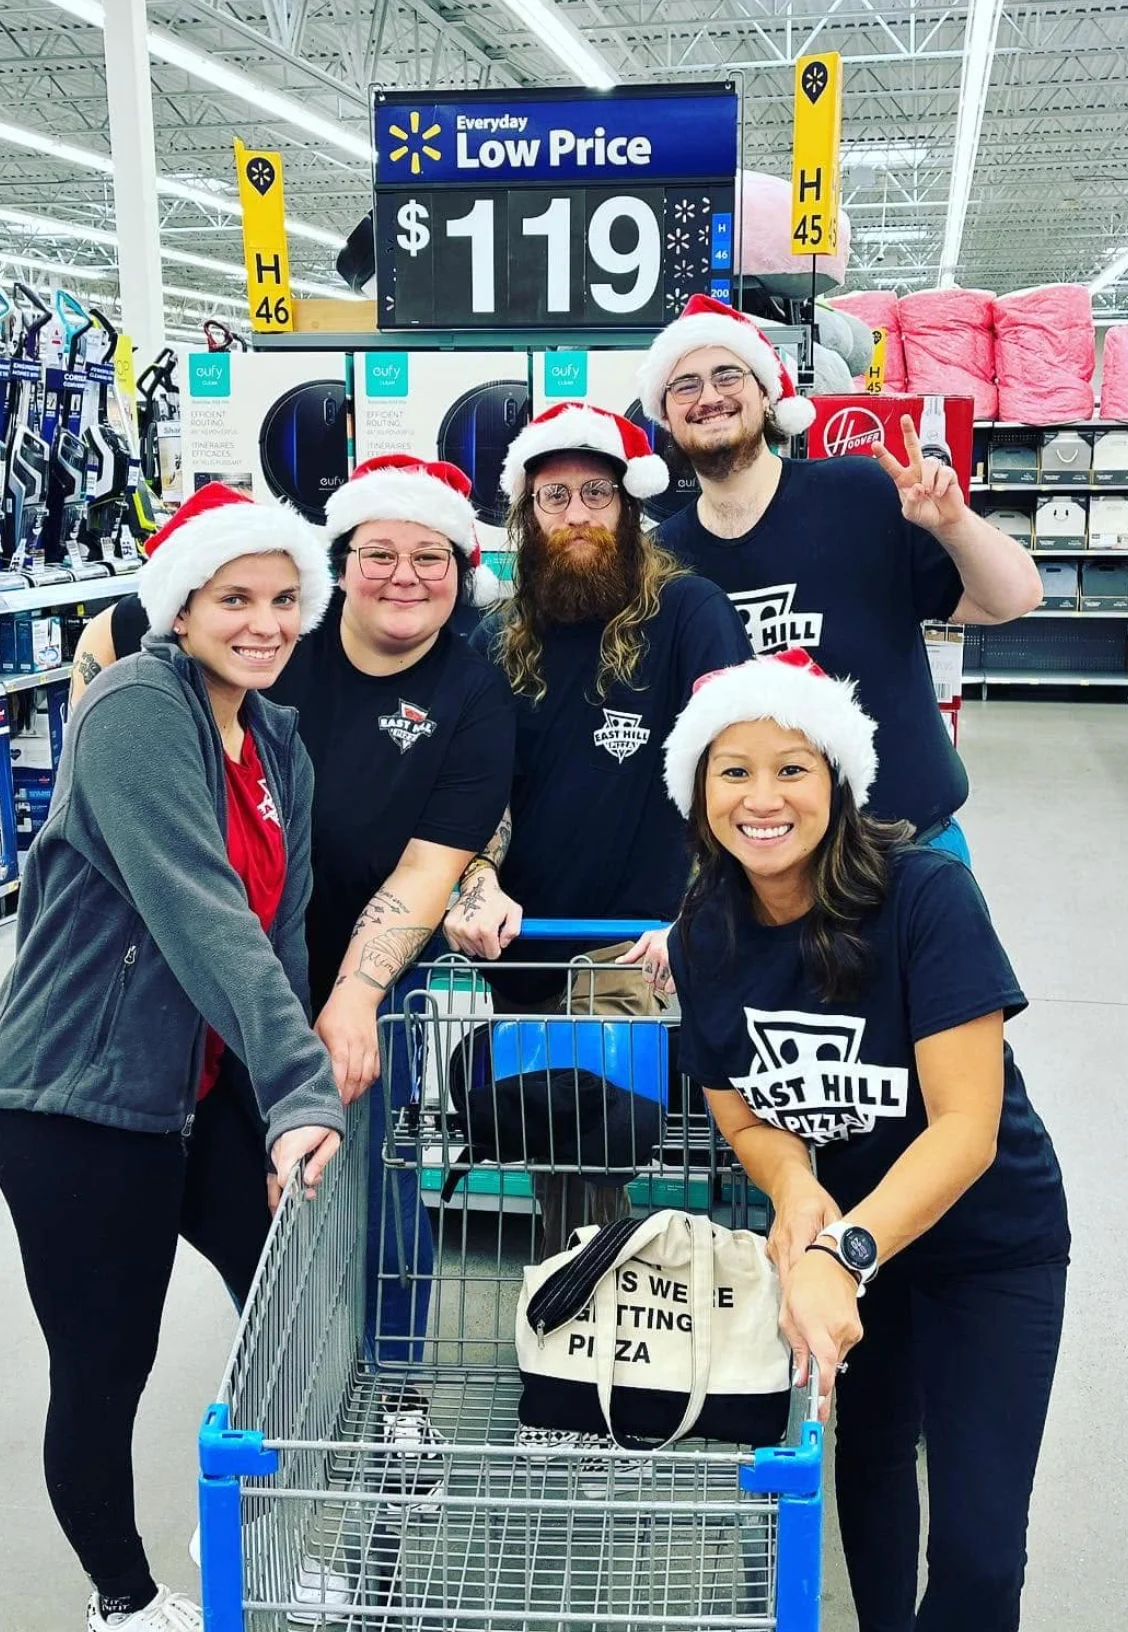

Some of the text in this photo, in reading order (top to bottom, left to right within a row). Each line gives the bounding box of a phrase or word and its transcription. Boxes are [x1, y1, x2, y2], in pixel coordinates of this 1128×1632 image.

[457, 115, 528, 132] Everyday
[456, 127, 652, 169] Low Price
[799, 167, 822, 203] H
[718, 223, 727, 234] H
[793, 214, 823, 246] 45
[714, 250, 729, 260] 46
[255, 253, 282, 285] H
[710, 288, 730, 299] 200
[254, 296, 290, 325] 46
[196, 365, 223, 380] eufy
[372, 364, 401, 380] eufy
[551, 363, 580, 380] eufy
[869, 366, 880, 379] H
[866, 381, 882, 393] 45
[677, 477, 697, 488] euf
[762, 620, 816, 647] HILL
[380, 718, 411, 731] EAST
[595, 730, 647, 742] EAST HILL
[820, 1073, 900, 1107] HILL
[575, 1301, 692, 1334] GTTING
[568, 1333, 651, 1364] PIZA
